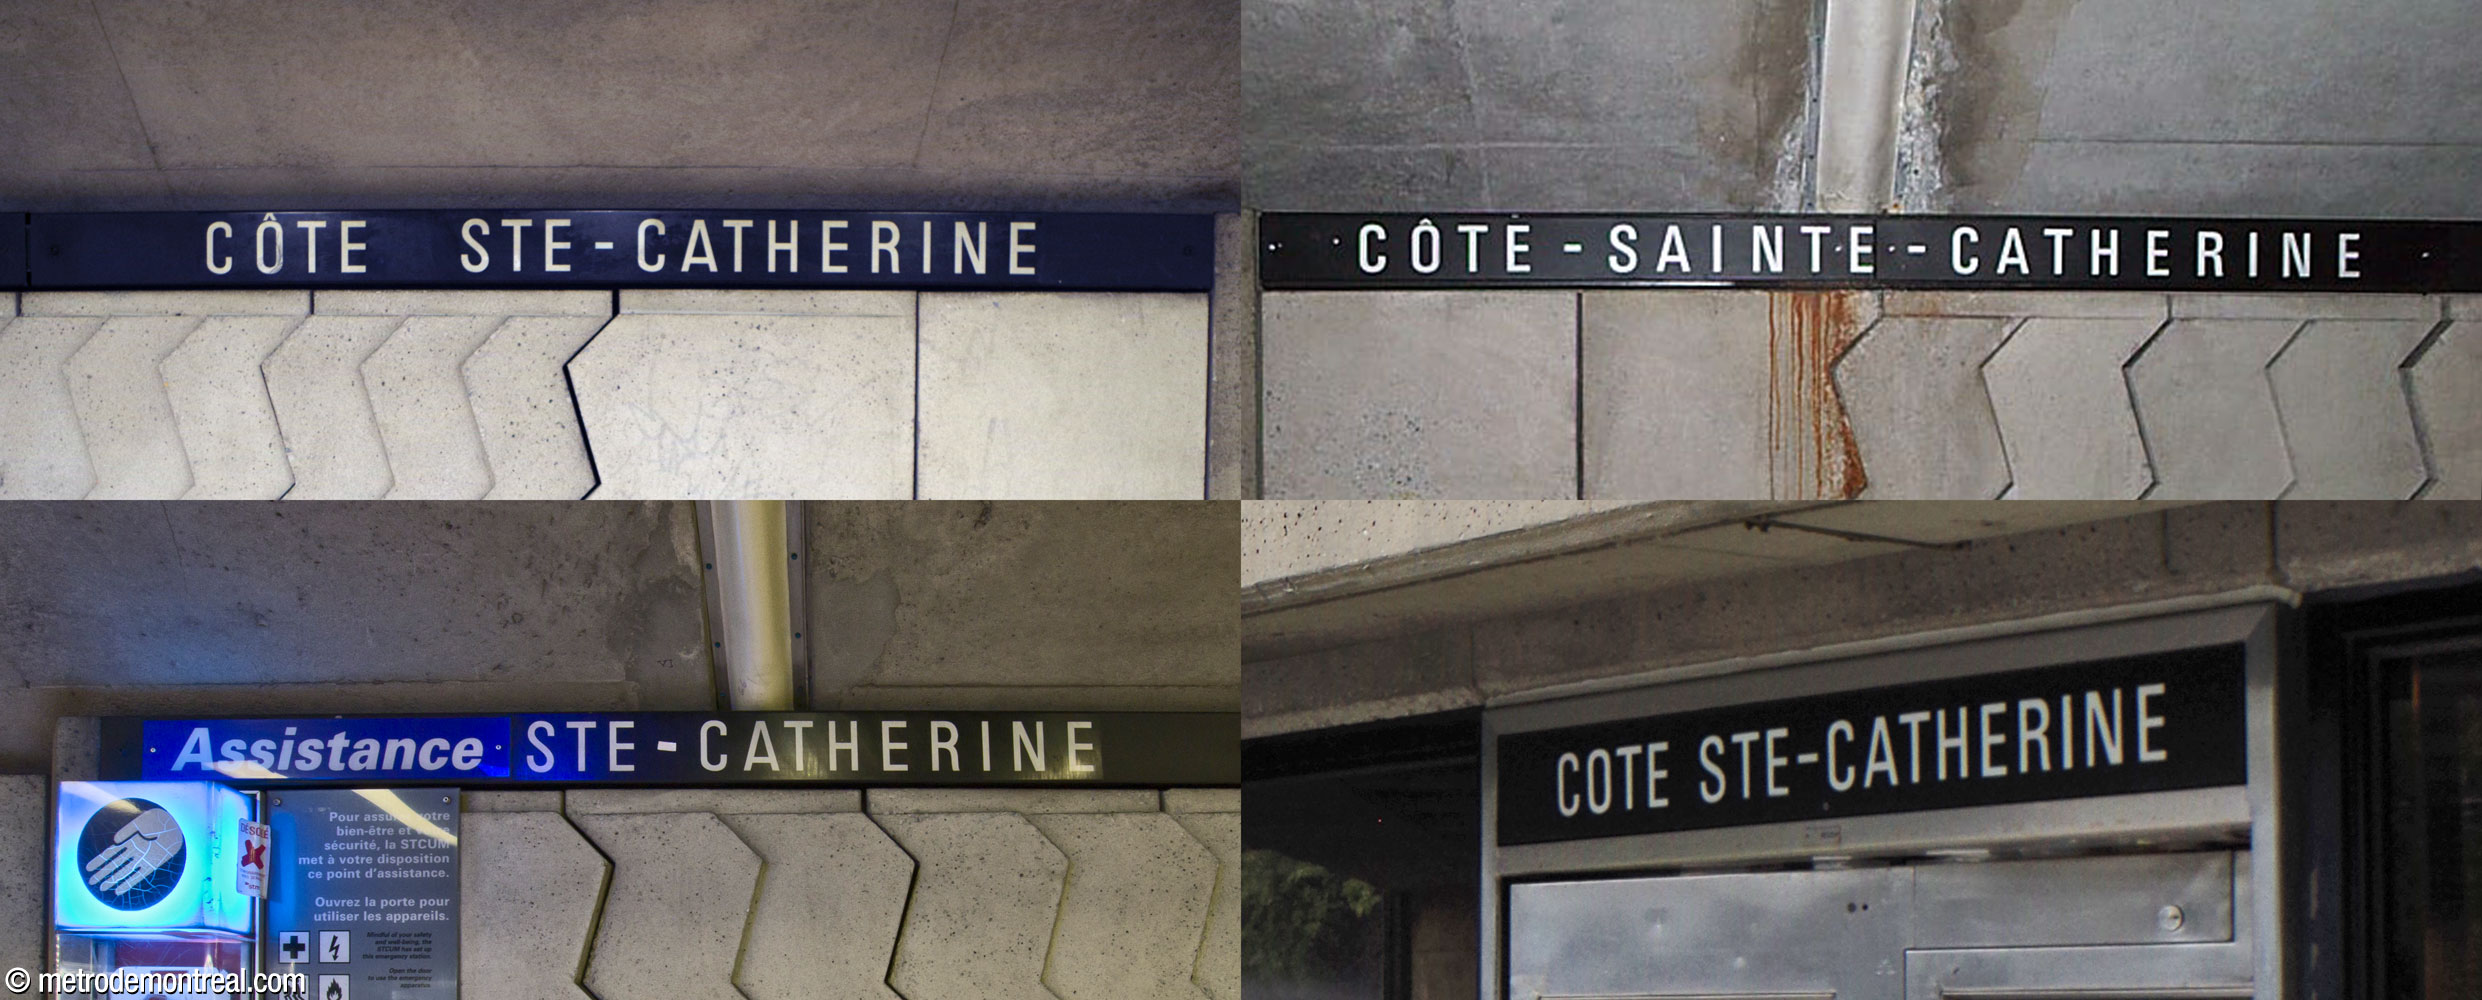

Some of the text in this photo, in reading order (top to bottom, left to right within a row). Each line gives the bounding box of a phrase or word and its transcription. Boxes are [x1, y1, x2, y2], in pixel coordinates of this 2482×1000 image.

[205, 212, 368, 275] CÔTE
[171, 726, 484, 772] Assistance
[1557, 683, 2167, 817] COTE STE-CATHERINE
[329, 812, 359, 822] Pour
[337, 826, 394, 836] bien-être
[398, 826, 411, 836] et
[324, 839, 450, 851] sécurité, la STCUM
[298, 854, 450, 866] met à votre disposition
[308, 868, 450, 880] ce point d'assistance.
[315, 896, 450, 909] Ouvrez la porte pour
[314, 910, 450, 923] utiliser les appareils.
